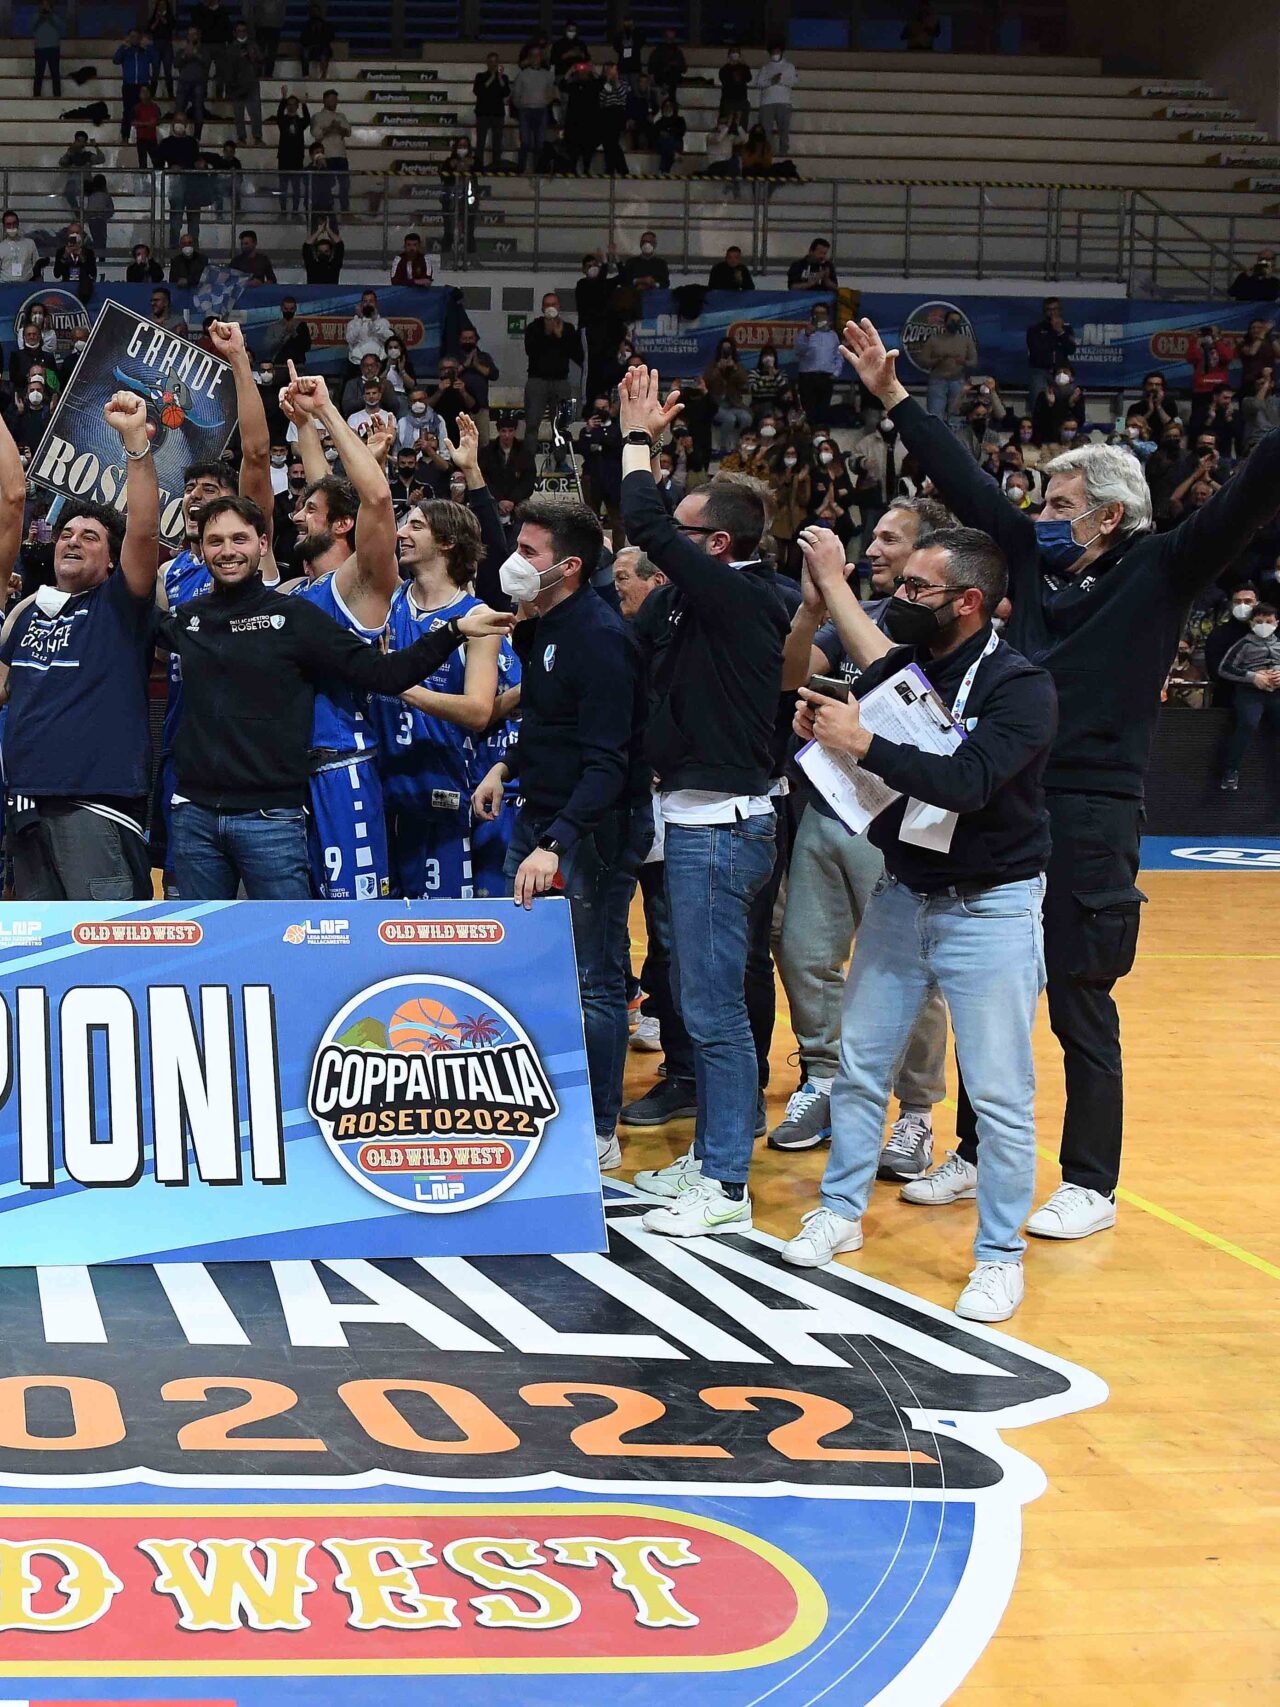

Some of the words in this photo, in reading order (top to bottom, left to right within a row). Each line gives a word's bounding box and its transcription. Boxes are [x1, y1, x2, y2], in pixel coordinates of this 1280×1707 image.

[126, 322, 227, 400] GRANDE
[35, 435, 185, 538] ROSO
[231, 619, 270, 633] ROSETO
[395, 711, 414, 746] 3
[324, 846, 343, 881] 9
[425, 858, 441, 890] 3
[79, 925, 111, 941] OLD
[112, 925, 152, 941] WILD
[152, 925, 197, 941] WEST
[305, 919, 349, 934] LNP
[385, 924, 416, 939] OLD
[417, 924, 456, 939] WILD
[455, 924, 498, 939] WEST
[315, 1050, 431, 1114] COPPA
[435, 1047, 552, 1110] ITALIA
[338, 1108, 535, 1136] ROSETO2022
[366, 1147, 404, 1167] OLD
[405, 1147, 452, 1166] WILD
[452, 1146, 506, 1166] WEST
[415, 1182, 465, 1201] LNP
[137, 1533, 701, 1631] WEST
